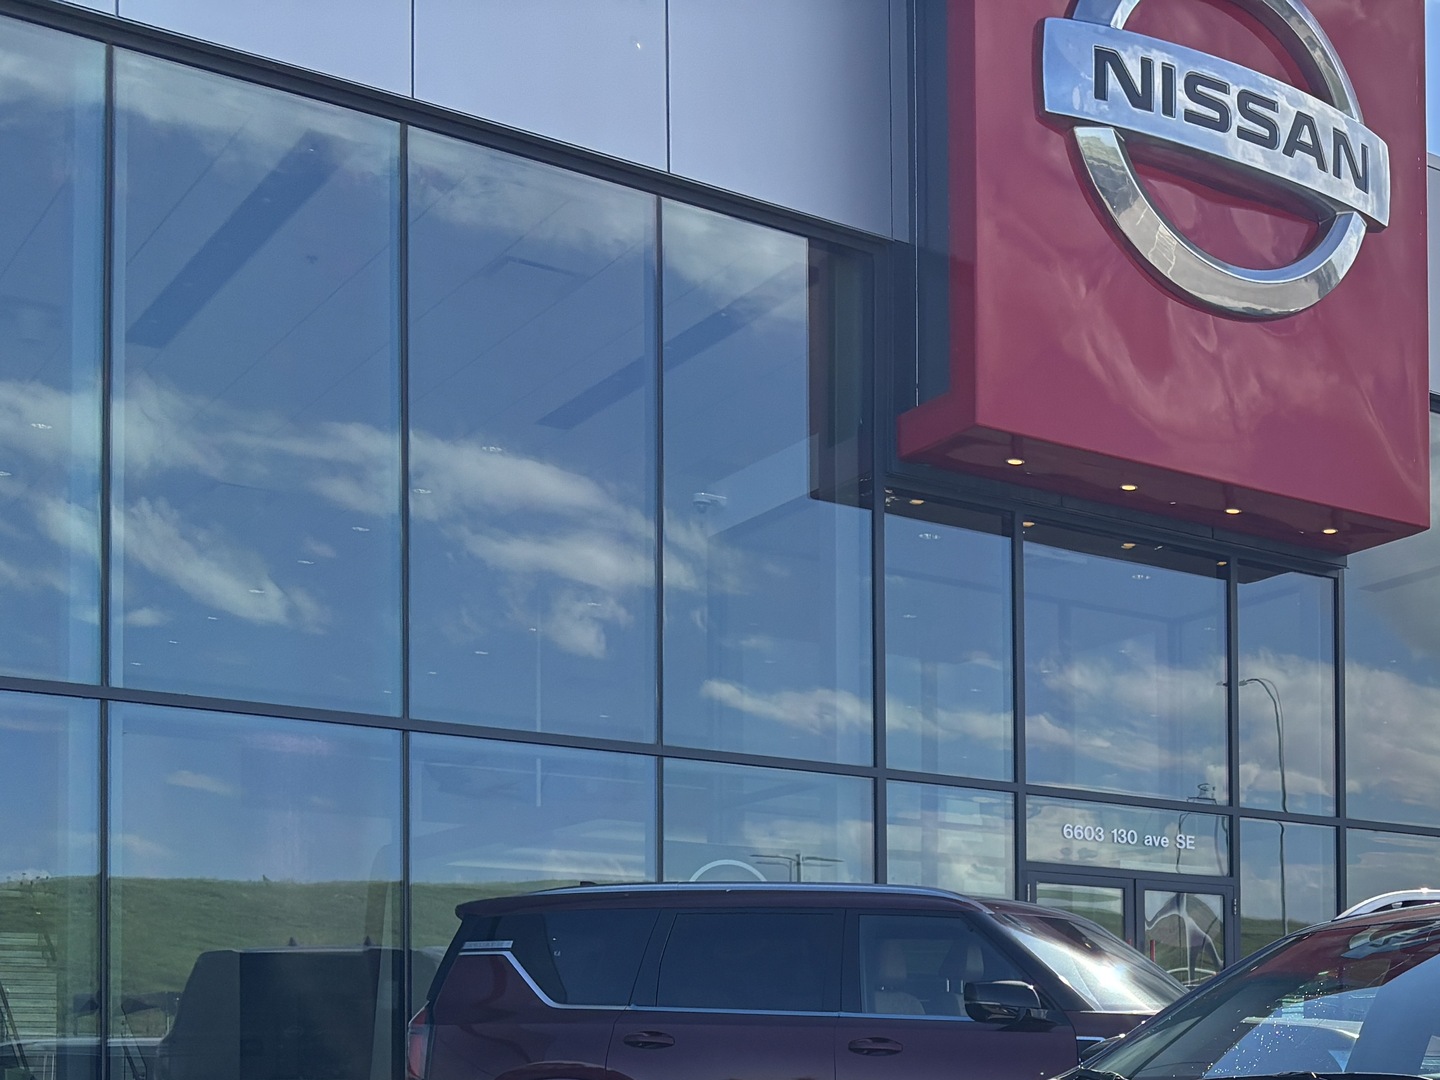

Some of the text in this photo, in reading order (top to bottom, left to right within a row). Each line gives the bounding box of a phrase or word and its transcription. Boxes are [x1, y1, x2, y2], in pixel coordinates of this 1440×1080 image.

[1093, 45, 1369, 195] NISSAN
[1063, 823, 1196, 850] 6603 130 ave SE
